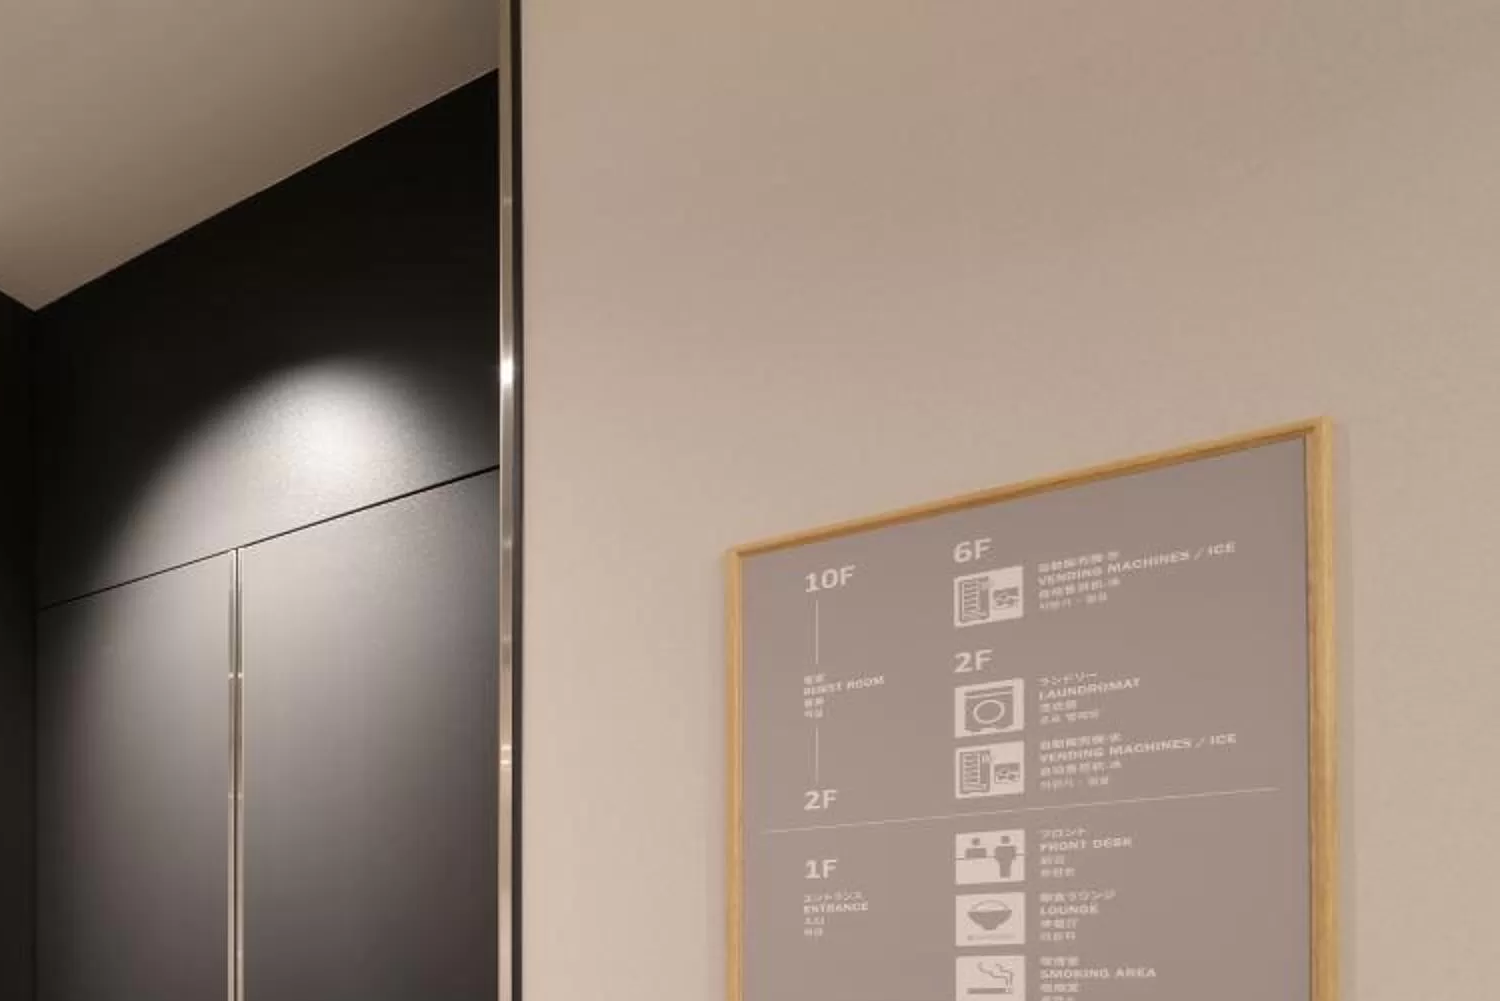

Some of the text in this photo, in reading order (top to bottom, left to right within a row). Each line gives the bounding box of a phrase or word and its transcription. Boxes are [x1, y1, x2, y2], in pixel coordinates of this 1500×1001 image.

[953, 538, 992, 563] 6F
[1107, 549, 1191, 574] MACHINES
[1208, 541, 1237, 556] ICE
[804, 564, 857, 593] 10F
[954, 650, 993, 673] 2F
[1039, 677, 1141, 701] LAUNDROMAT
[1040, 747, 1104, 763] VENDING
[1109, 738, 1193, 757] MACHINES
[1209, 733, 1237, 746] ICE
[804, 789, 838, 811] 2F
[1039, 838, 1087, 853] FRONT
[804, 859, 838, 880] 1F
[1039, 968, 1111, 980] SMOKING
